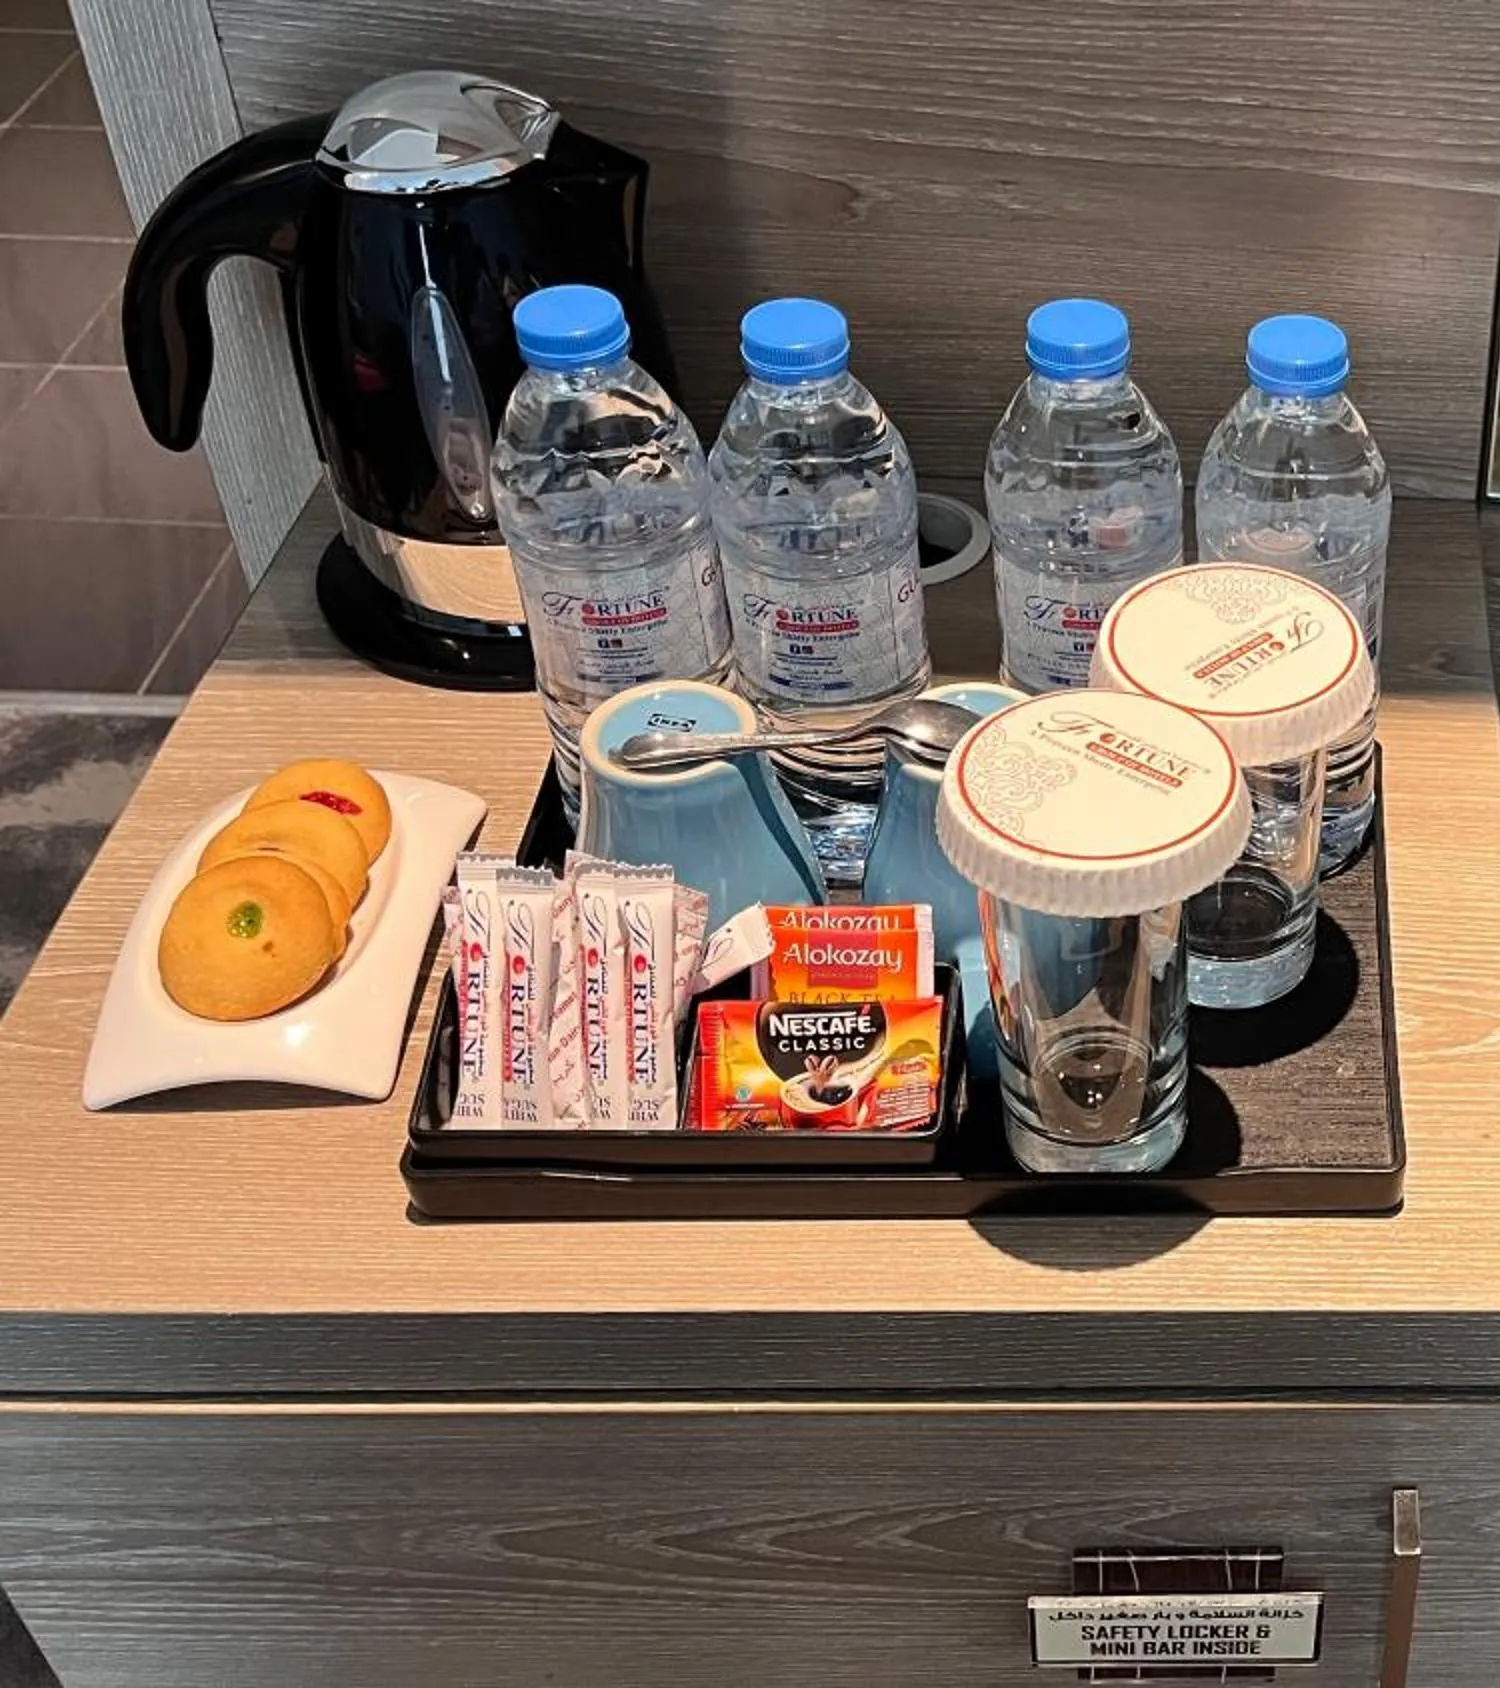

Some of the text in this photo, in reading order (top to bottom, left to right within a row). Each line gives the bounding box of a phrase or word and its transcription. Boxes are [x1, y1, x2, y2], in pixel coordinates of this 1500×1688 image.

[1037, 711, 1190, 777] FORTUNE
[783, 943, 903, 974] Alokozay
[778, 1036, 867, 1053] CLASSIC
[1081, 1624, 1272, 1640] SAFETY LOCKER &
[1090, 1640, 1262, 1656] MINI BAR INSIDE
